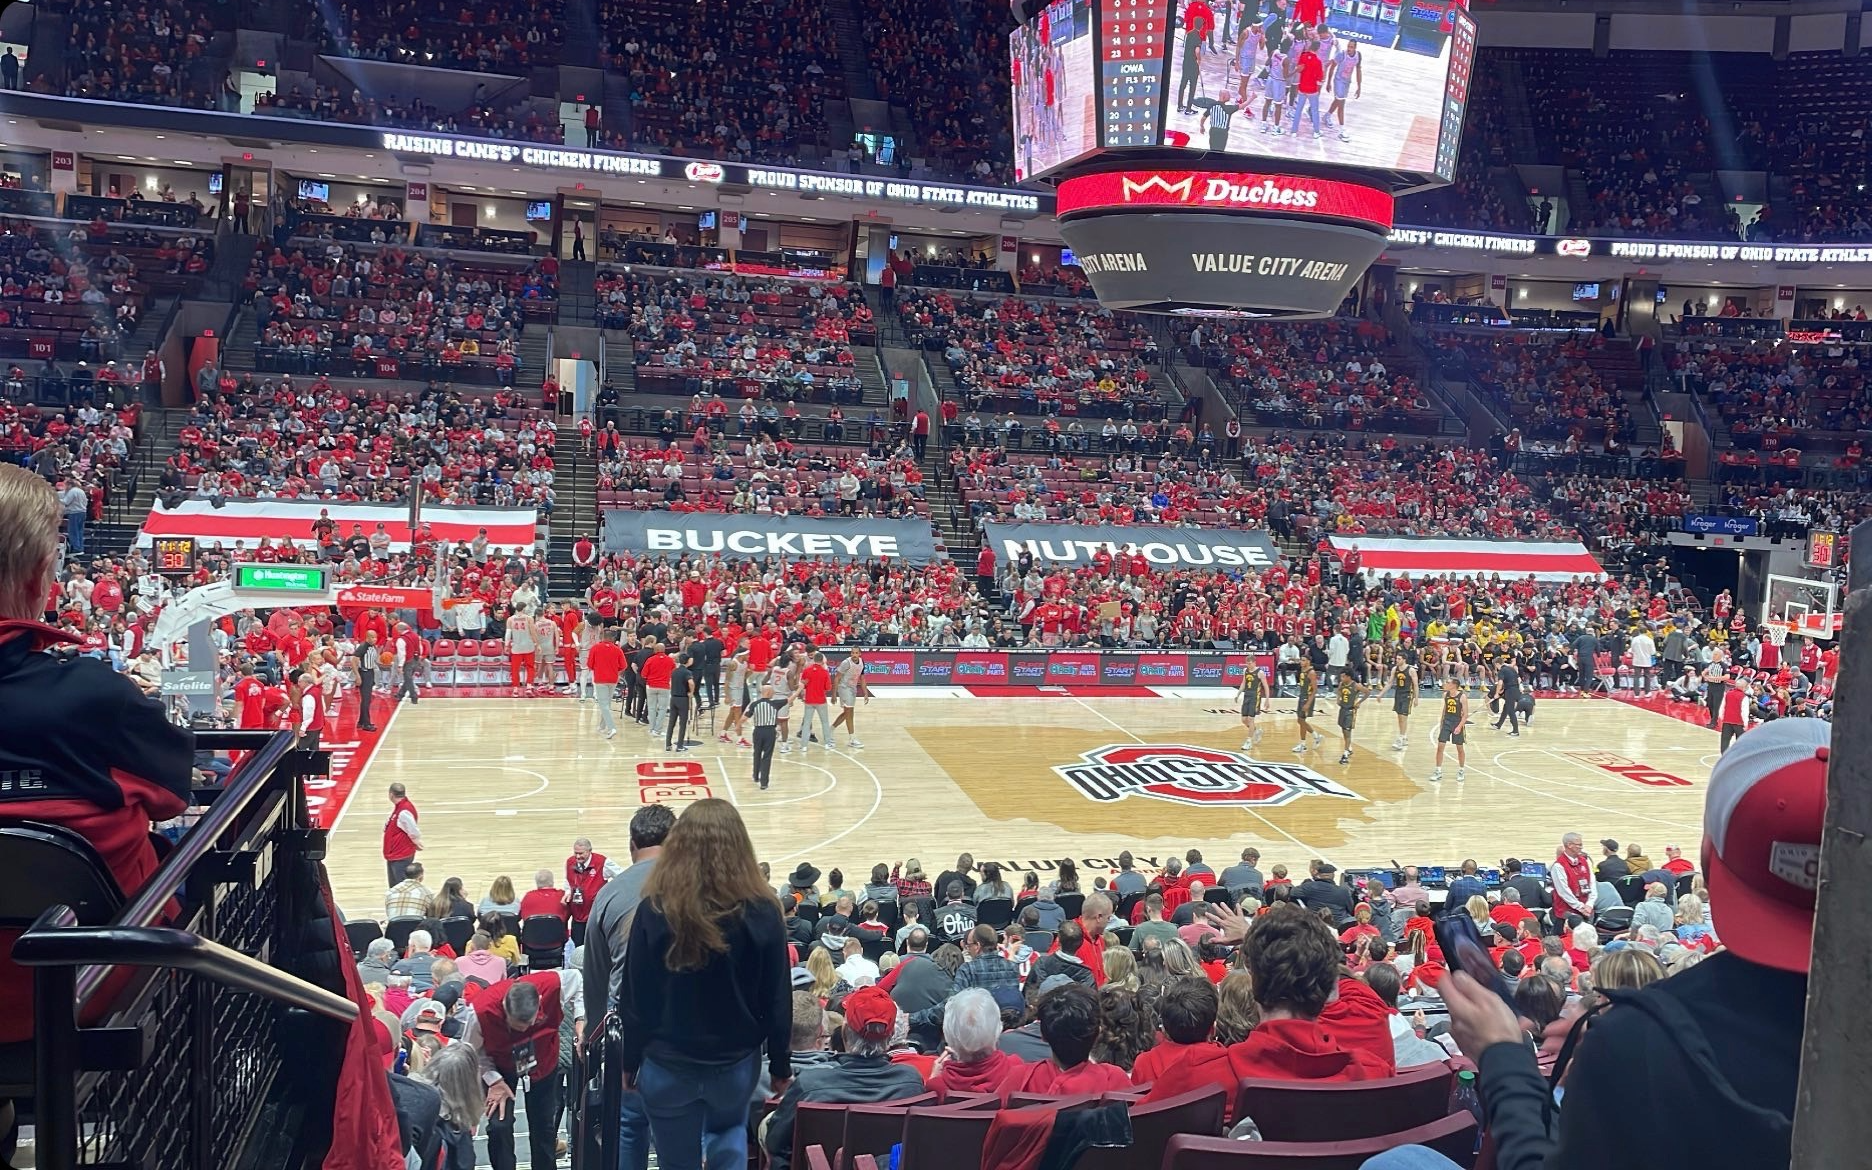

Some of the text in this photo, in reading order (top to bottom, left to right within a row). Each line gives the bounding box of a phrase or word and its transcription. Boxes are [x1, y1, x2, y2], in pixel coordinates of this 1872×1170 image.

[1130, 36, 1136, 44] 0
[1120, 64, 1144, 73] IOWA
[1126, 76, 1138, 84] FLS
[1142, 75, 1156, 83] PTS
[1109, 112, 1119, 120] 20
[384, 134, 452, 155] RAISING
[523, 148, 591, 169] CHICKEN
[594, 154, 661, 175] FINGERS
[55, 157, 72, 166] 203
[409, 187, 425, 196] 204
[749, 169, 1039, 209] PROUD SPONSOR OF OHIO STATE ATHLETICS
[1204, 179, 1318, 208] Duchess
[1434, 232, 1484, 249] CHICKEN
[1485, 236, 1536, 253] FINGERS
[1611, 242, 1655, 257] PROUD
[1658, 243, 1718, 259] SPONSOR
[1721, 246, 1738, 260] OF
[1740, 247, 1773, 261] OHIO
[1775, 248, 1819, 262] STATE
[1101, 253, 1147, 272] ARENA
[1192, 253, 1348, 281] VALUE CITY ARENA
[34, 343, 51, 352] 101
[380, 364, 396, 372] 104
[745, 385, 759, 393] 105
[1063, 404, 1077, 412] 106
[1691, 517, 1750, 533] Kroger Kroger
[159, 541, 191, 552] 11:12
[646, 528, 900, 556] BUCKEYE
[164, 553, 184, 568] 30
[1185, 616, 1194, 628] N
[1202, 619, 1210, 630] U
[1222, 622, 1230, 635] T
[1266, 617, 1274, 630] U
[1286, 620, 1294, 633] S
[1304, 623, 1312, 635] E
[1013, 666, 1044, 674] START
[163, 682, 212, 690] Safelite
[1447, 706, 1457, 714] 20
[1066, 759, 1356, 801] OHIO STATE
[943, 912, 975, 934] Ohio
